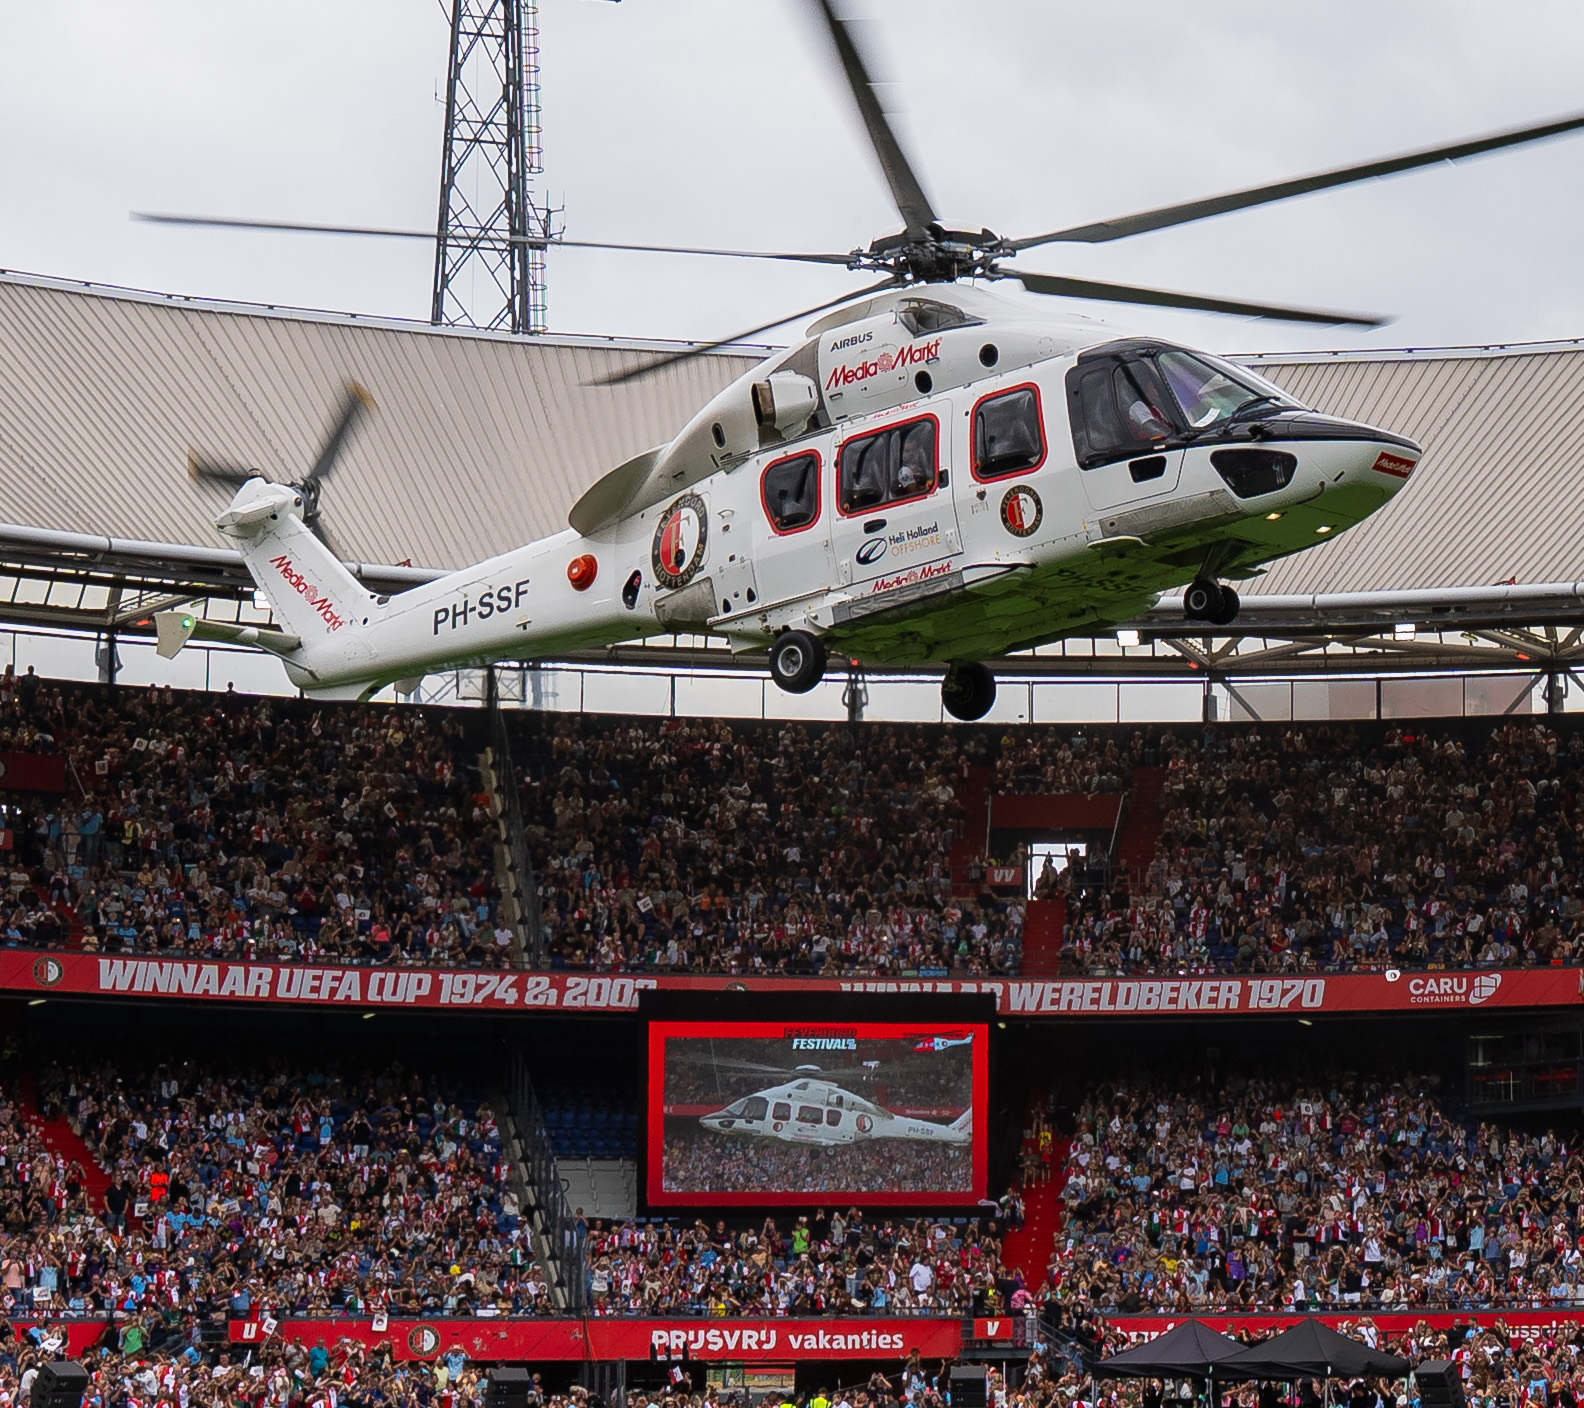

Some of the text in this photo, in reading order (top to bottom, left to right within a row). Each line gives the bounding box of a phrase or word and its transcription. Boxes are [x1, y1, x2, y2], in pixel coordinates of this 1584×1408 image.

[830, 332, 873, 352] AIRBUS
[889, 521, 938, 545] Heli Holland
[891, 535, 941, 557] OFFSHORE
[433, 579, 530, 635] PH-SSF
[98, 958, 272, 997] WINNAAR
[276, 966, 361, 1002] UEFA
[367, 970, 432, 1004] CUP
[437, 972, 518, 1006] 1974
[1408, 978, 1467, 996] CARU
[1008, 979, 1239, 1013] WERELDBEKER
[1245, 978, 1325, 1011] 1970
[1410, 995, 1466, 1004] CONTAINERS
[792, 1038, 847, 1050] FESTIVAL
[986, 1321, 999, 1336] V
[788, 1329, 904, 1350] vakanties
